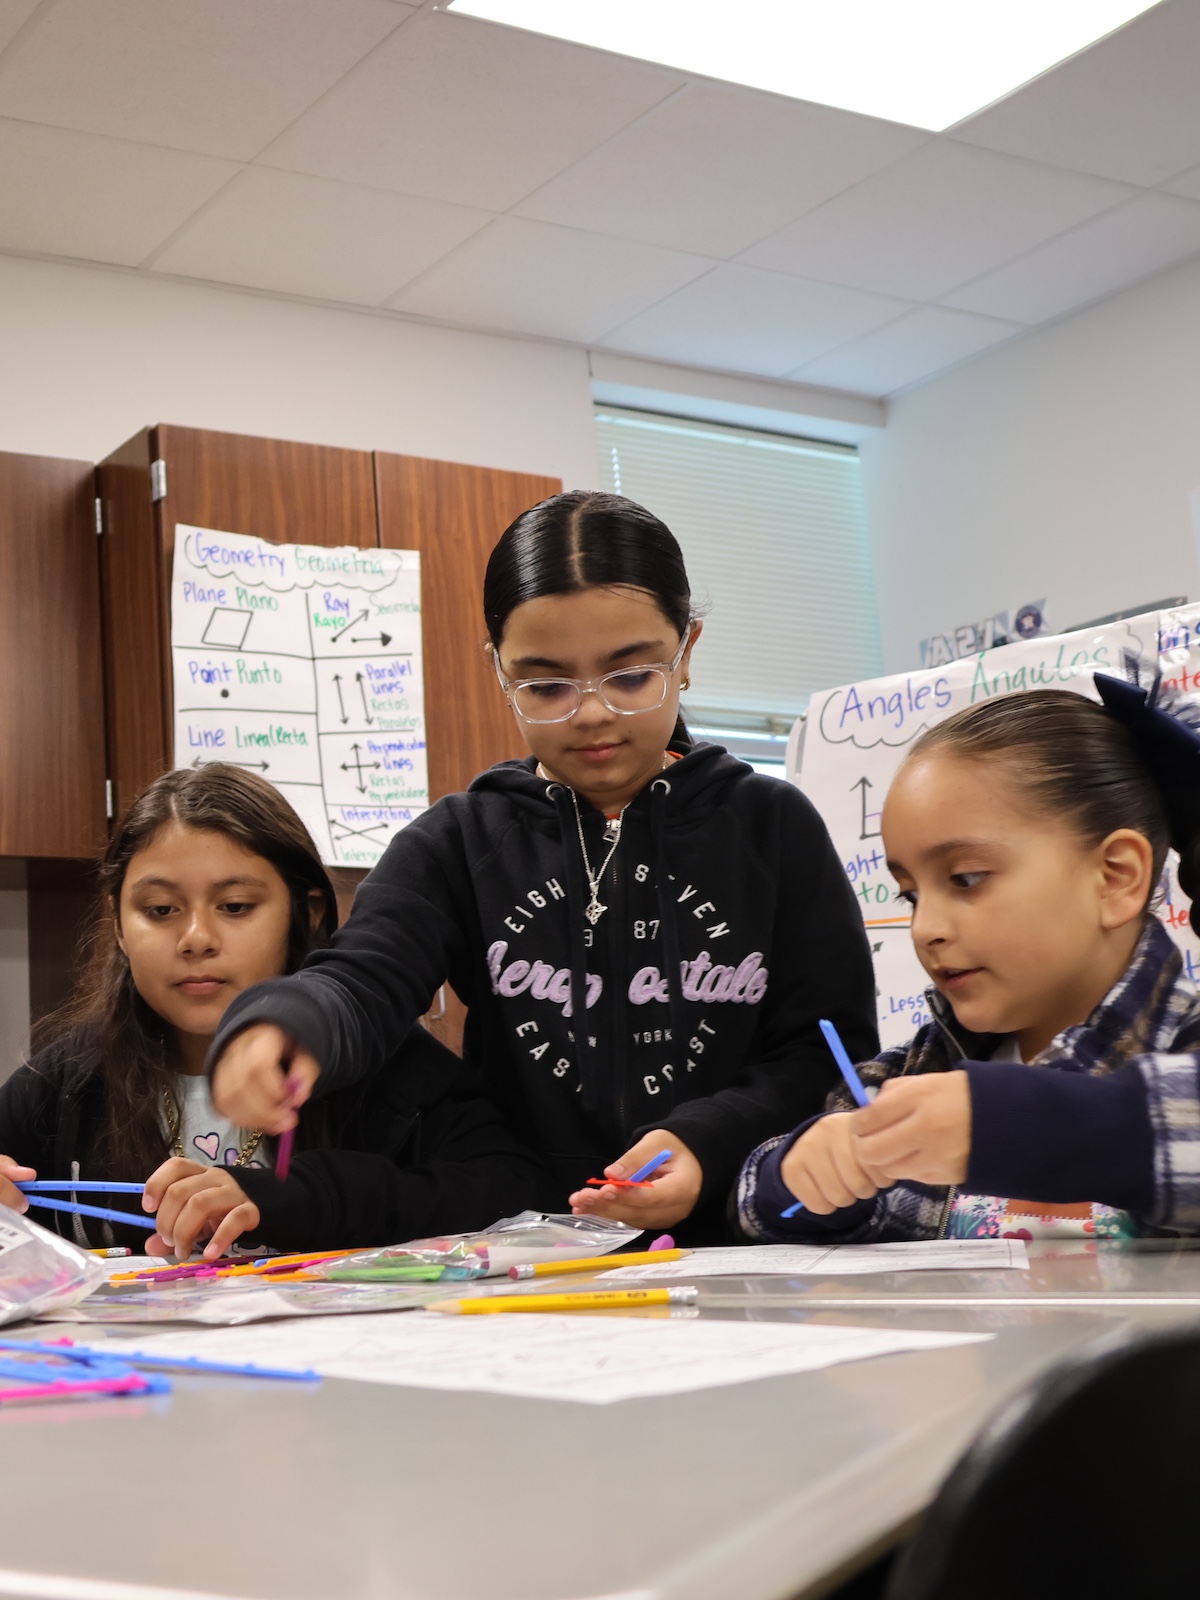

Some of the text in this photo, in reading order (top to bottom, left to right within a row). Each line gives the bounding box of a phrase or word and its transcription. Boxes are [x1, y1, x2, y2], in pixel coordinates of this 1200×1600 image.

[195, 531, 285, 577] Geometry
[182, 581, 280, 612] Plane Plano
[322, 591, 350, 618] Ray
[313, 613, 347, 630] Rayo
[235, 658, 283, 685] Punto
[364, 659, 413, 682] Parallel
[839, 677, 952, 729] Angles
[187, 724, 227, 748] Line
[846, 848, 884, 883] ght
[503, 862, 732, 940] EIGH SVEN
[632, 1027, 673, 1046] YORK
[514, 1019, 583, 1094] EAS
